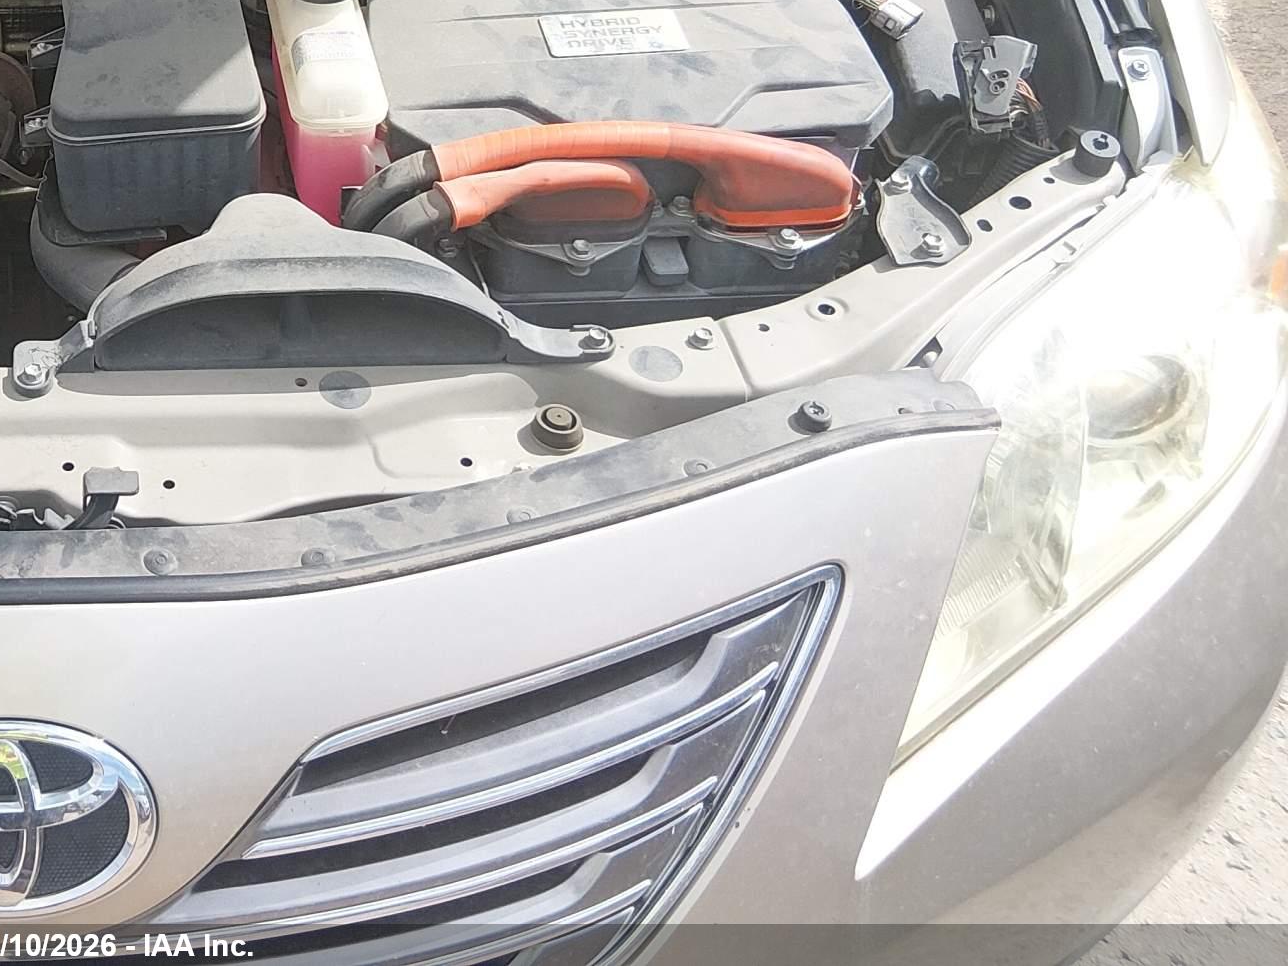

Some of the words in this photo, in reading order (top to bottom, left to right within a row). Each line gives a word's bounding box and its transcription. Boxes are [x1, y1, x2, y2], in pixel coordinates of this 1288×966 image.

[559, 16, 641, 29] HYBRID
[562, 25, 663, 38] SYNERGY
[566, 36, 633, 49] DRIVE
